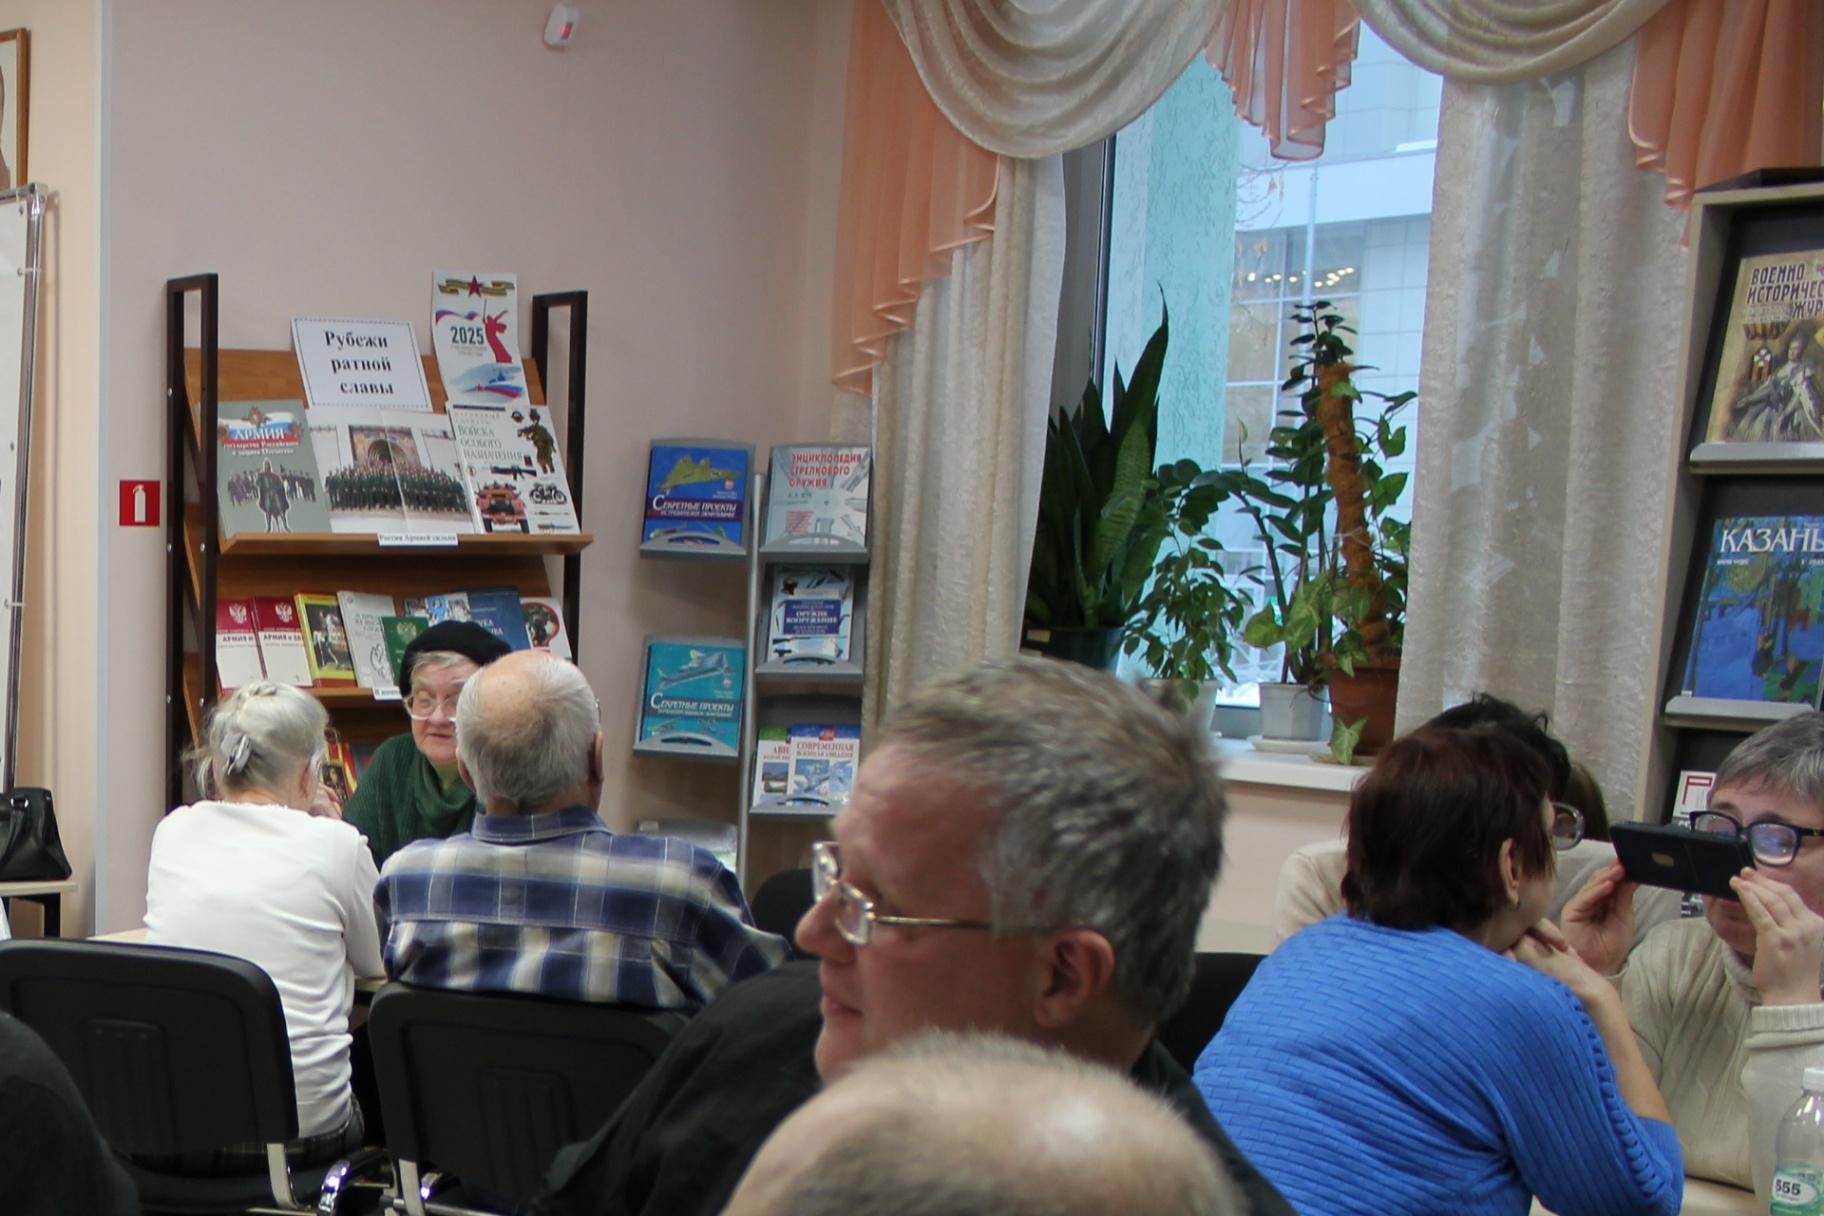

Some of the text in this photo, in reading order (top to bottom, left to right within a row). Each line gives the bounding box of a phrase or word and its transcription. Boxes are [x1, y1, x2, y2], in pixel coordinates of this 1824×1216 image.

[1752, 263, 1805, 285] ВОЕННО
[325, 331, 388, 351] Рубежи
[450, 326, 485, 345] 2025
[330, 357, 392, 374] ратной
[340, 383, 394, 395] славы
[236, 427, 285, 440] АРМИЯ
[457, 425, 495, 437] ВОЙСКА
[460, 439, 502, 448] ОСОБОГО
[463, 449, 523, 460] НАЗНАЧЕНИЯ
[792, 454, 862, 463] ЭНЦИКЛОПЕДИЯ
[791, 466, 850, 475] СТРЕЛКОВОГО
[788, 479, 827, 487] ОРУЖИЯ
[1720, 528, 1824, 552] КАЗАНЬ
[797, 742, 854, 751] СОВРЕМЕННАЯ
